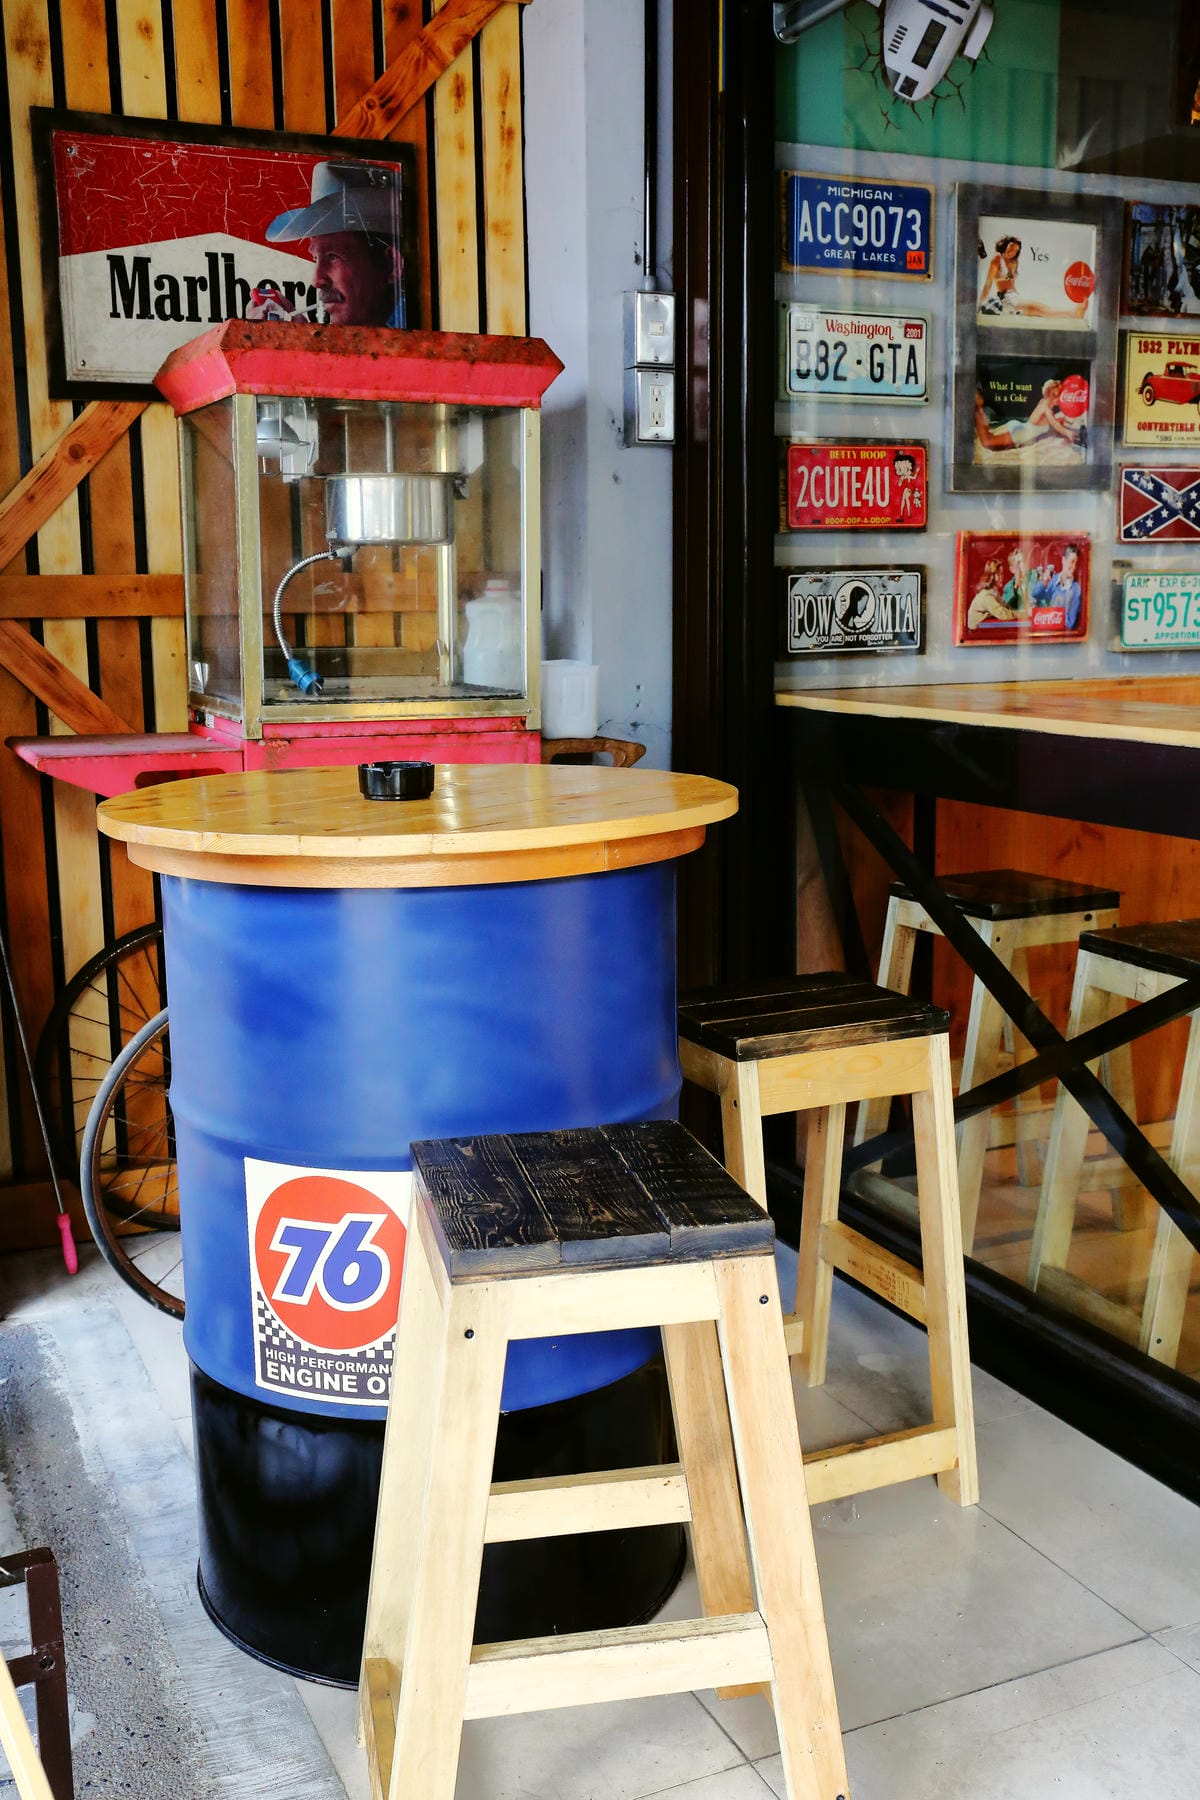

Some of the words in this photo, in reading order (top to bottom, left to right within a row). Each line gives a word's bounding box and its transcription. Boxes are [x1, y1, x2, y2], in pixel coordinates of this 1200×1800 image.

[828, 186, 893, 201] MICHIGAN
[799, 200, 922, 250] ACC9073
[824, 249, 857, 260] GREAT
[863, 252, 896, 262] LAKES
[907, 255, 923, 266] JAN
[1030, 246, 1049, 262] Yes
[825, 319, 894, 340] Washington
[905, 328, 921, 338] 2001
[1138, 340, 1162, 354] 1932
[989, 381, 1008, 391] What
[1010, 382, 1014, 391] I
[1015, 383, 1032, 391] want
[995, 393, 1001, 402] is
[1010, 393, 1028, 402] Coke
[1137, 421, 1195, 433] CONVERTIBLE
[829, 450, 857, 460] BETTY
[860, 450, 887, 460] BOOP
[796, 465, 890, 509] 2CUTE4U
[1159, 577, 1178, 588] EXP
[793, 594, 833, 636] POW
[877, 593, 915, 633] MIA
[816, 635, 829, 643] YOU
[831, 634, 843, 643] ARE
[845, 634, 857, 642] NOT
[859, 633, 893, 642] FORGOTTEN
[273, 1216, 386, 1308] 76
[265, 1347, 296, 1365] HIGH
[300, 1356, 393, 1375] PERFORMAN
[266, 1361, 358, 1393] ENGINE
